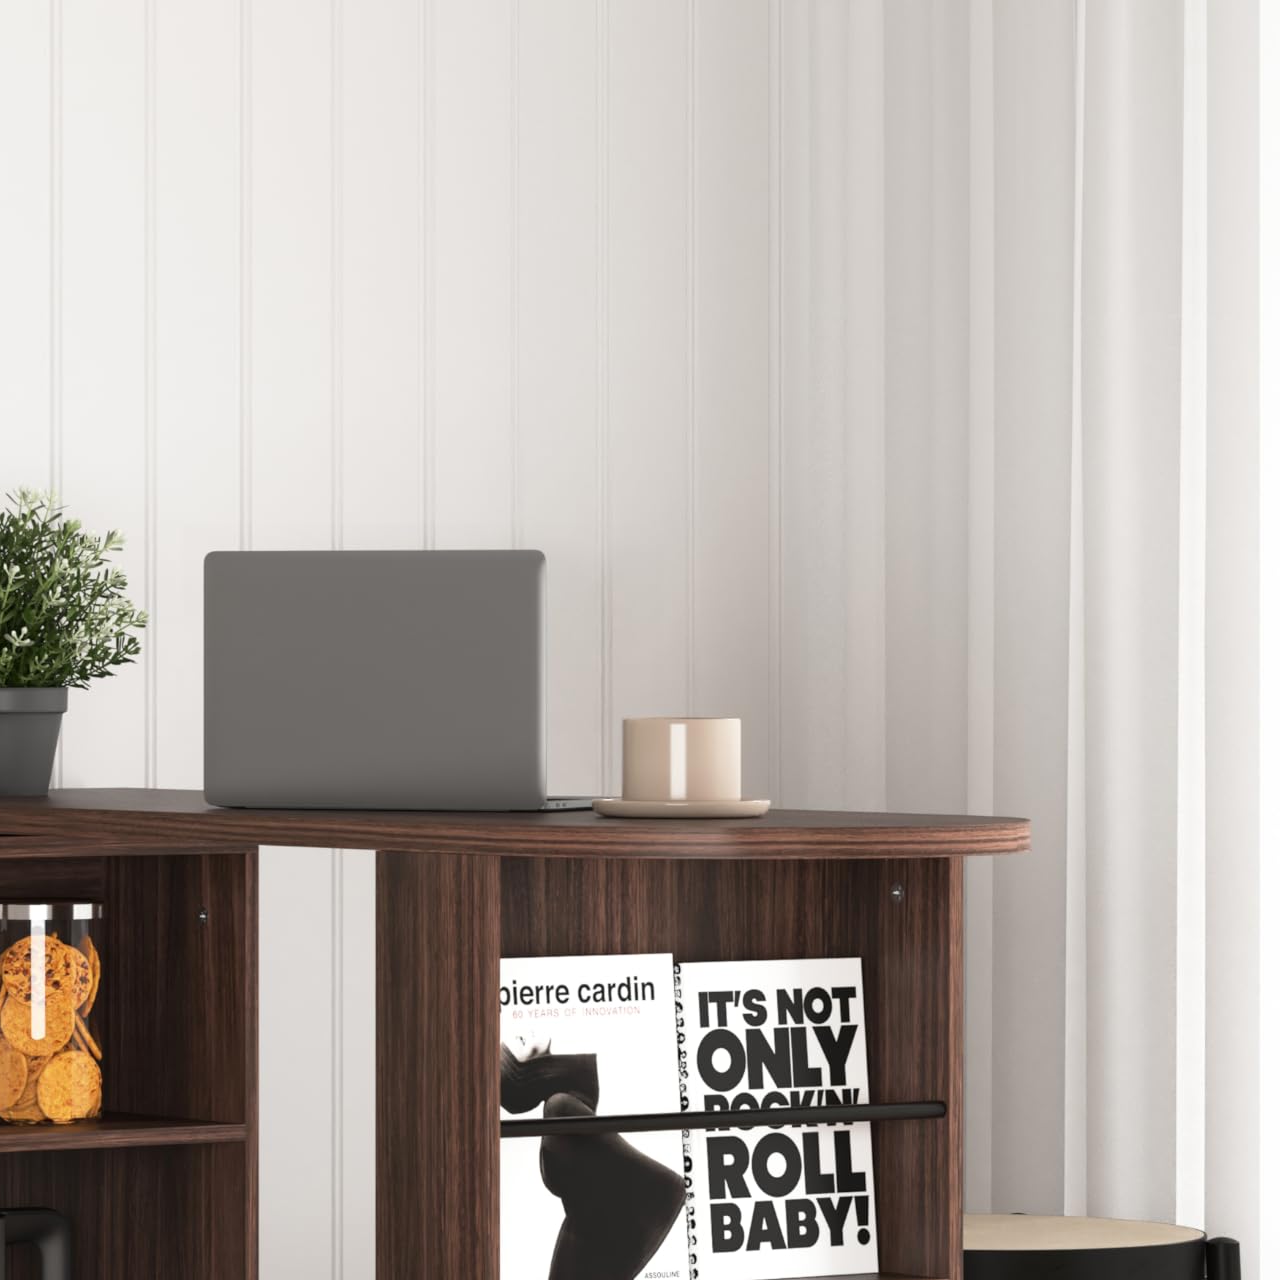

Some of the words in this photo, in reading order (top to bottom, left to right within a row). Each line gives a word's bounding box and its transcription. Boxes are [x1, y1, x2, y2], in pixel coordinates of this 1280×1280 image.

[500, 979, 570, 1006] pierre
[577, 975, 655, 1004] cardin
[697, 990, 768, 1028] IT'S
[777, 986, 857, 1026] NOT
[528, 1007, 560, 1019] YEARS
[582, 1005, 641, 1017] INNOVATION
[696, 1024, 859, 1092] ONLY
[706, 1130, 867, 1199] ROLL
[710, 1194, 871, 1254] BABY!
[644, 1270, 681, 1280] ASSOULINE
